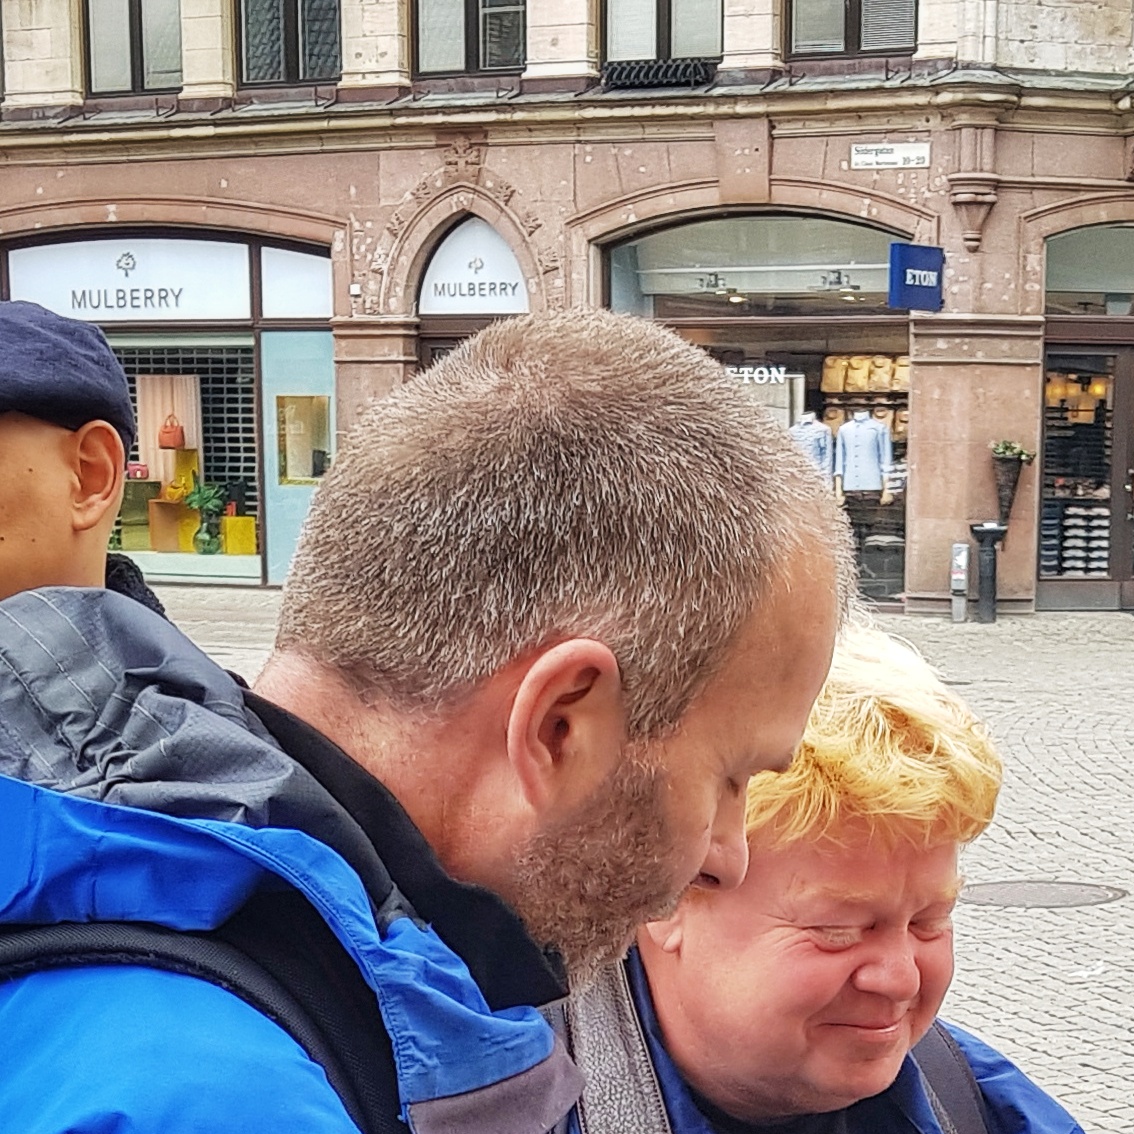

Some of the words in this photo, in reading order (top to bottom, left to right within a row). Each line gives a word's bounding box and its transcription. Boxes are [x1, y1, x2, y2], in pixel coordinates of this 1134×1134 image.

[905, 268, 938, 287] ETON
[71, 288, 183, 309] MULBERRY
[434, 282, 519, 297] MULBERRY
